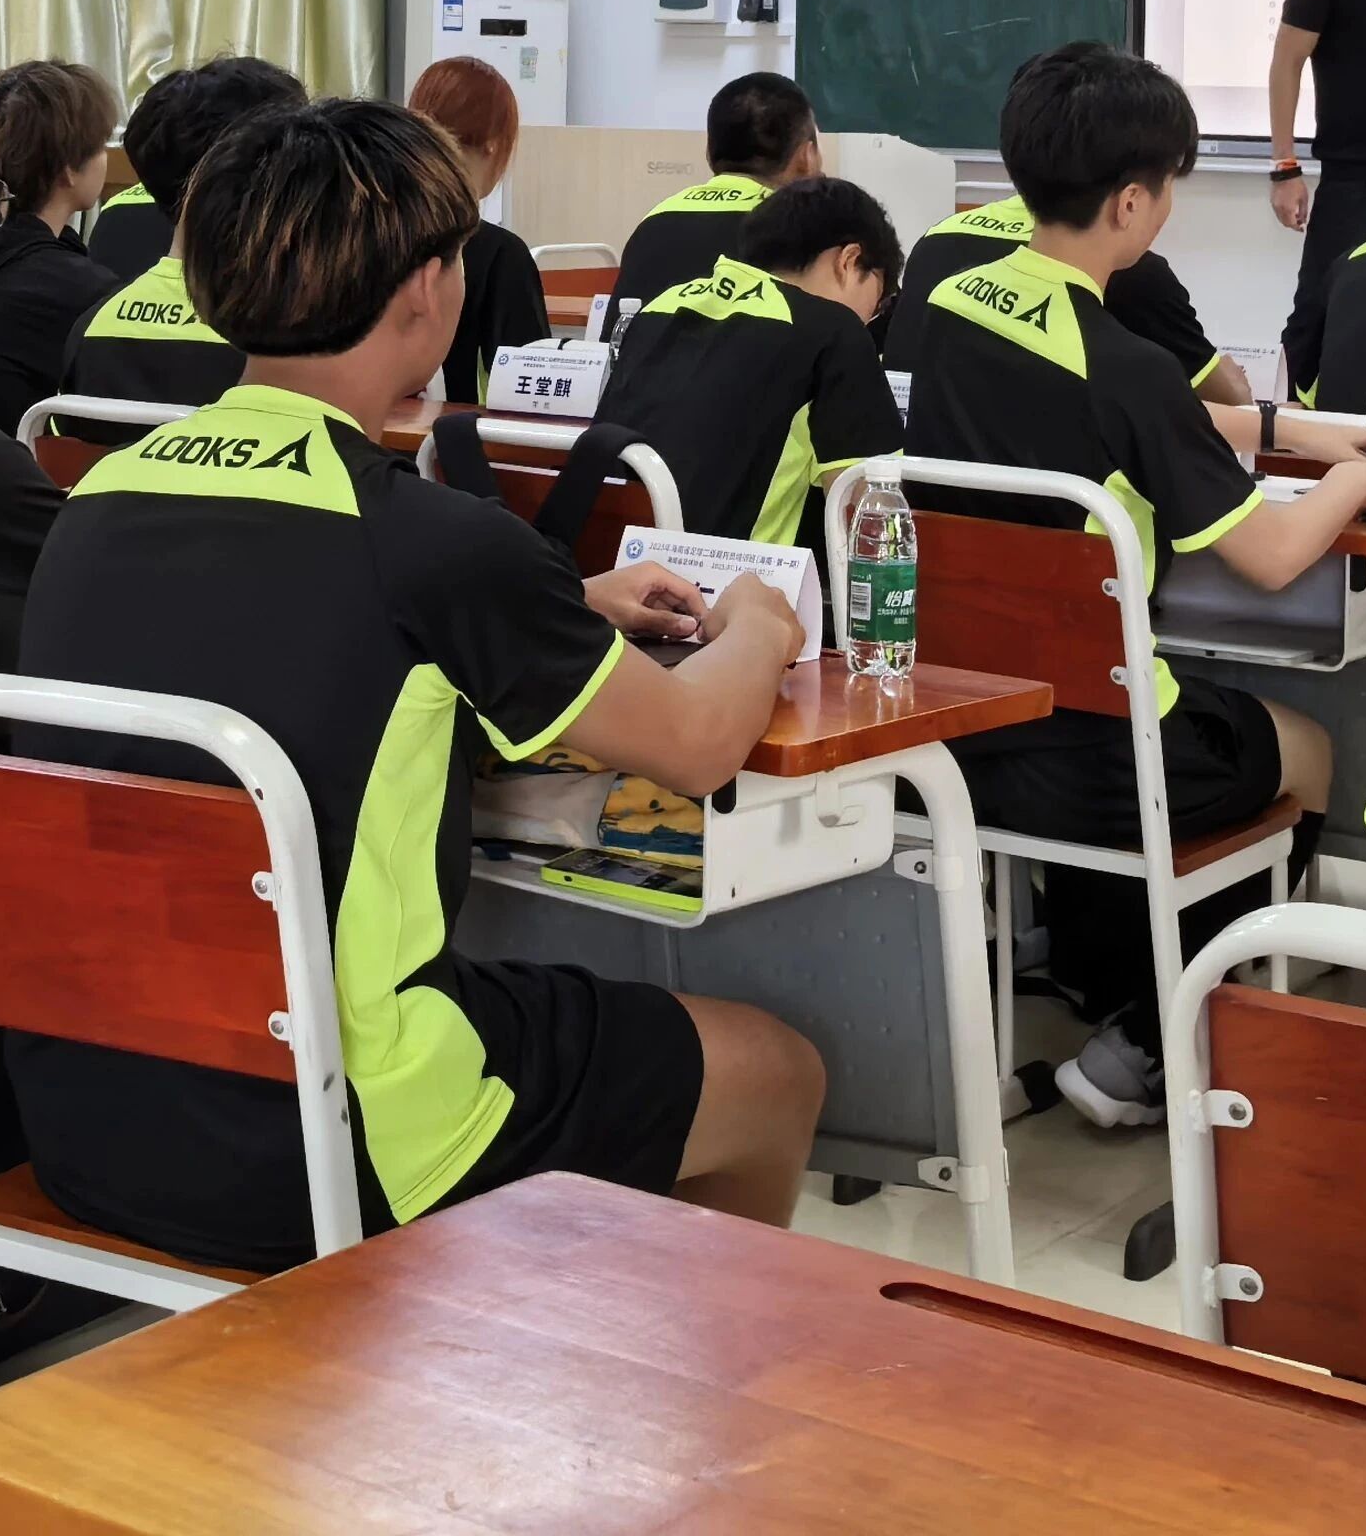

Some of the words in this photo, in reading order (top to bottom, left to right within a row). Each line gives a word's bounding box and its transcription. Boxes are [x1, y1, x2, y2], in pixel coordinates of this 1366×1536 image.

[685, 188, 741, 202] LOOKS
[961, 214, 1022, 234] LOOKS
[955, 274, 1019, 313] LOOKS
[117, 300, 183, 325] LOOKS
[514, 375, 572, 398] 王堂麒
[140, 434, 260, 468] LOOKS
